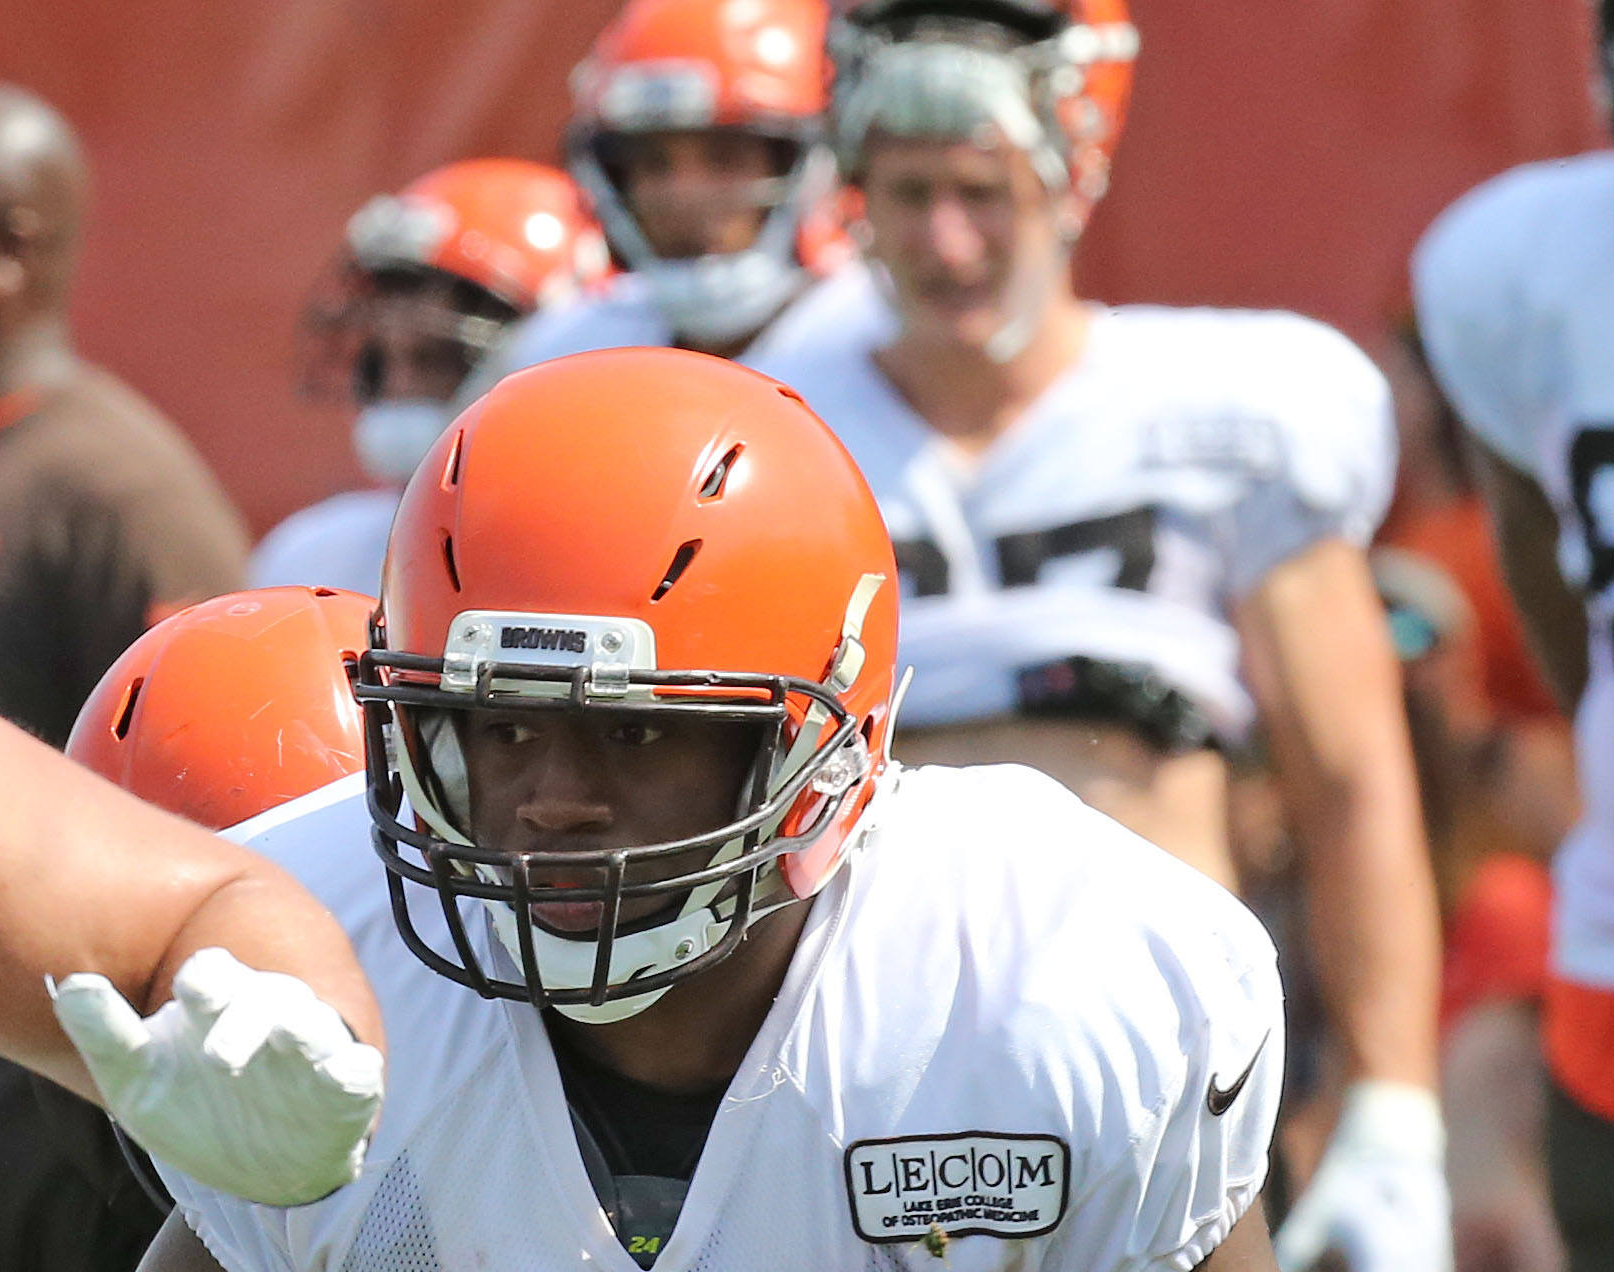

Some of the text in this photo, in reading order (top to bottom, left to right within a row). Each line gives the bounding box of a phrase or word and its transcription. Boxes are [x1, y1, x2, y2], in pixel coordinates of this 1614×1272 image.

[500, 626, 587, 653] BROWNS
[860, 1148, 1055, 1197] LECOM
[903, 1194, 1014, 1213] LAKE ERIE COLLEGE
[882, 1215, 899, 1228] OF
[628, 1235, 661, 1254] 24
